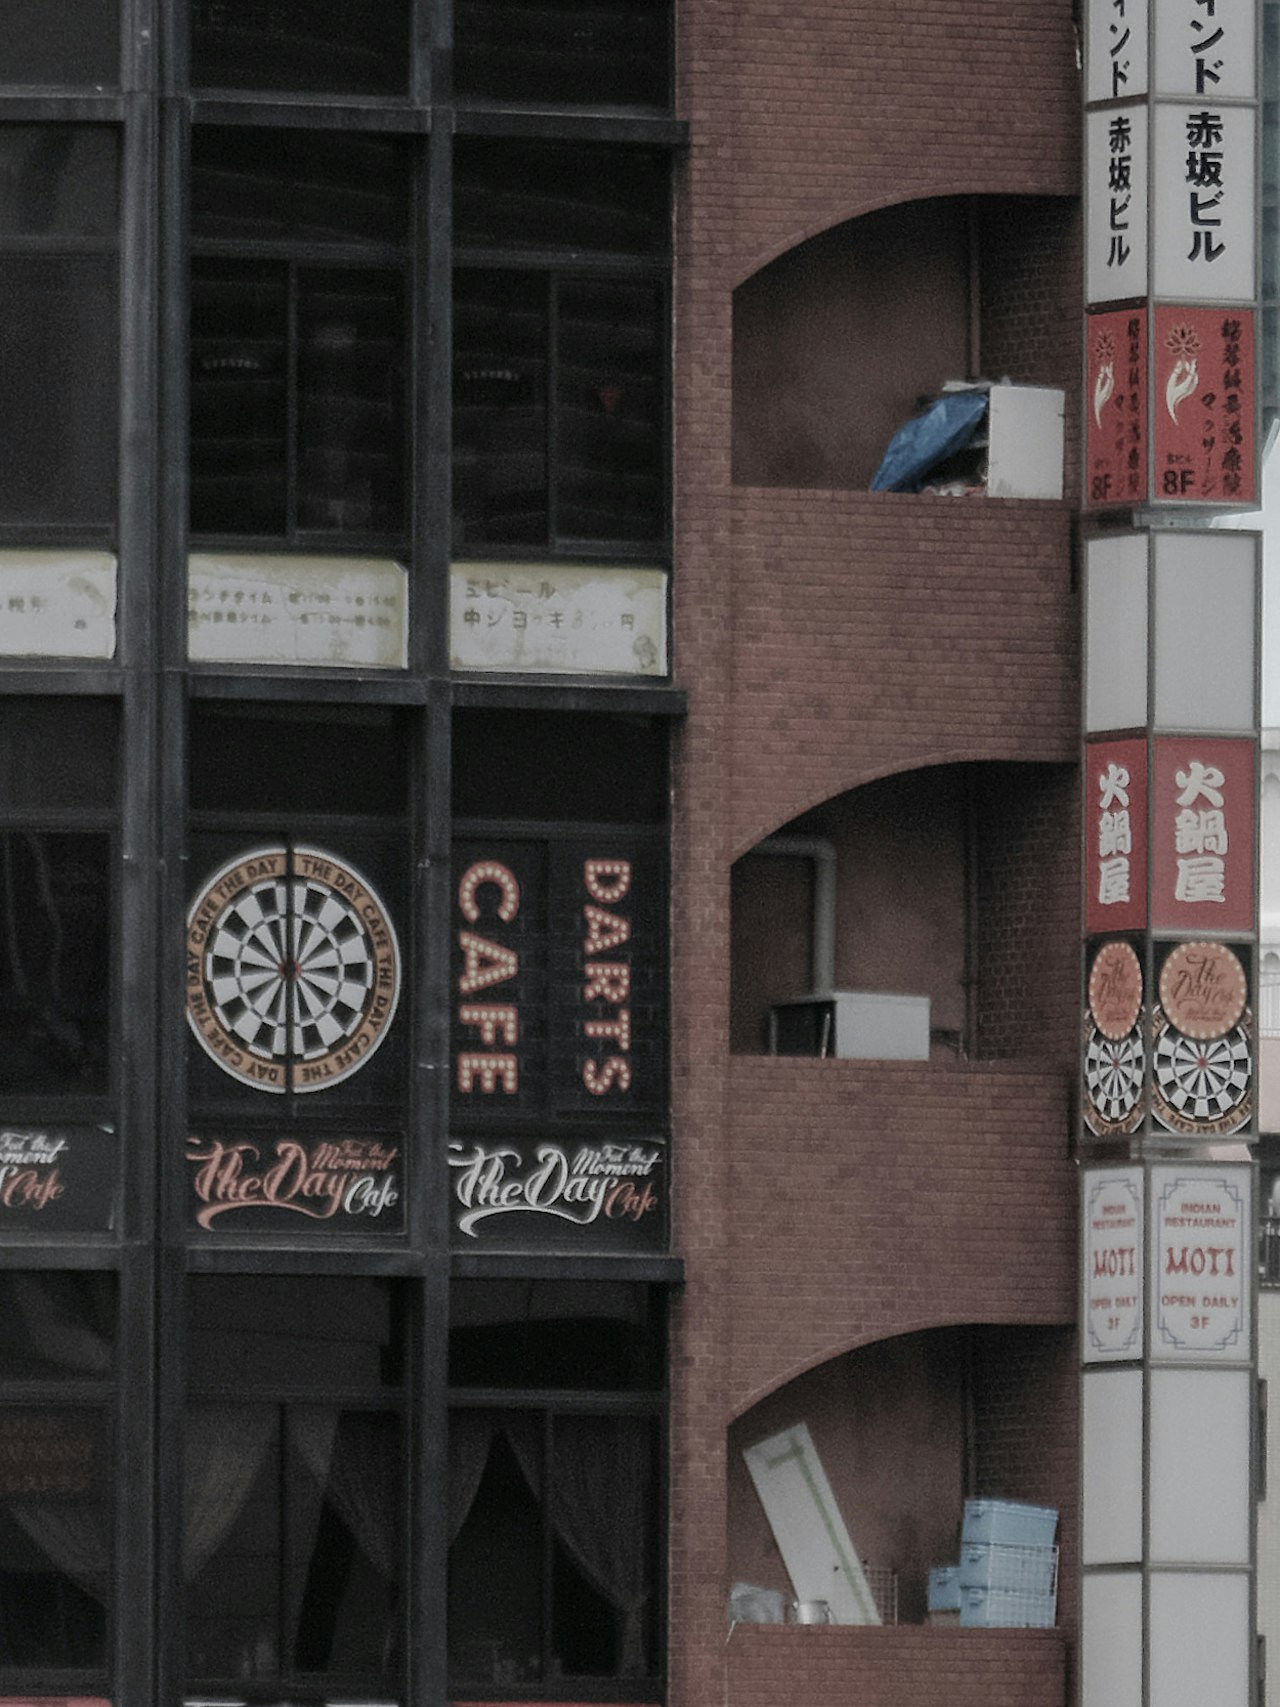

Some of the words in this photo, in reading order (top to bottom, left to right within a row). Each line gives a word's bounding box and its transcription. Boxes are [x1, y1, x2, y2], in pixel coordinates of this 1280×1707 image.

[1107, 116, 1131, 268] 赤坂ビル
[1186, 112, 1226, 263] 赤坂ビル
[1162, 470, 1195, 496] 8F
[1099, 764, 1131, 904] 火鍋屋
[1175, 762, 1228, 903] 火鍋屋
[217, 875, 244, 899] THE
[248, 858, 278, 878] DAY
[303, 859, 331, 877] THE
[337, 876, 364, 900] DAY
[459, 860, 520, 1095] CAFE
[583, 858, 631, 1096] DARTS
[186, 1137, 261, 1201] The
[448, 1145, 523, 1208] The
[573, 1148, 662, 1175] Moment
[3, 1170, 64, 1210] Cafe
[344, 1176, 398, 1217] Cafe
[605, 1183, 657, 1222] Cafe
[1181, 1203, 1221, 1214] INDIAN
[1165, 1217, 1236, 1228] RESTAURANT
[1093, 1247, 1135, 1278] MOTI
[1166, 1247, 1234, 1276] MOTI
[1162, 1296, 1196, 1307] OPEN
[1203, 1297, 1238, 1308] DAILY
[1191, 1316, 1210, 1329] 3F
